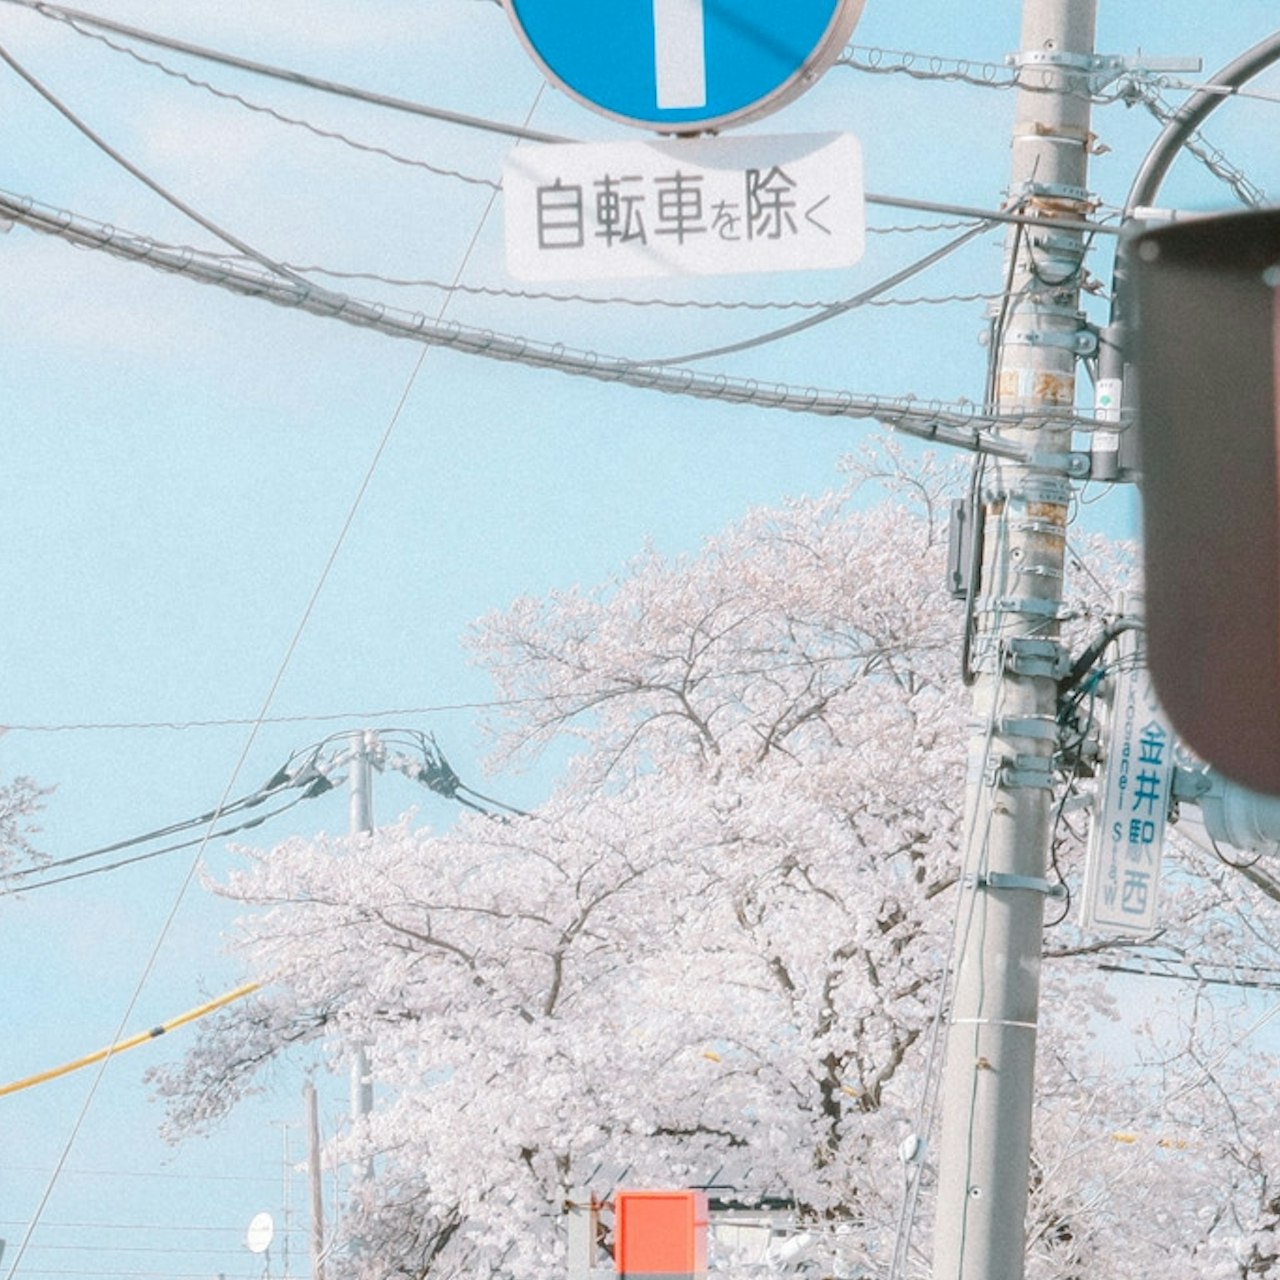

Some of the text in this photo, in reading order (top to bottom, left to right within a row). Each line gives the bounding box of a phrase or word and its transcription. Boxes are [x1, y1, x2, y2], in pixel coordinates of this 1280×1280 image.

[535, 166, 832, 250] 自転車を除く
